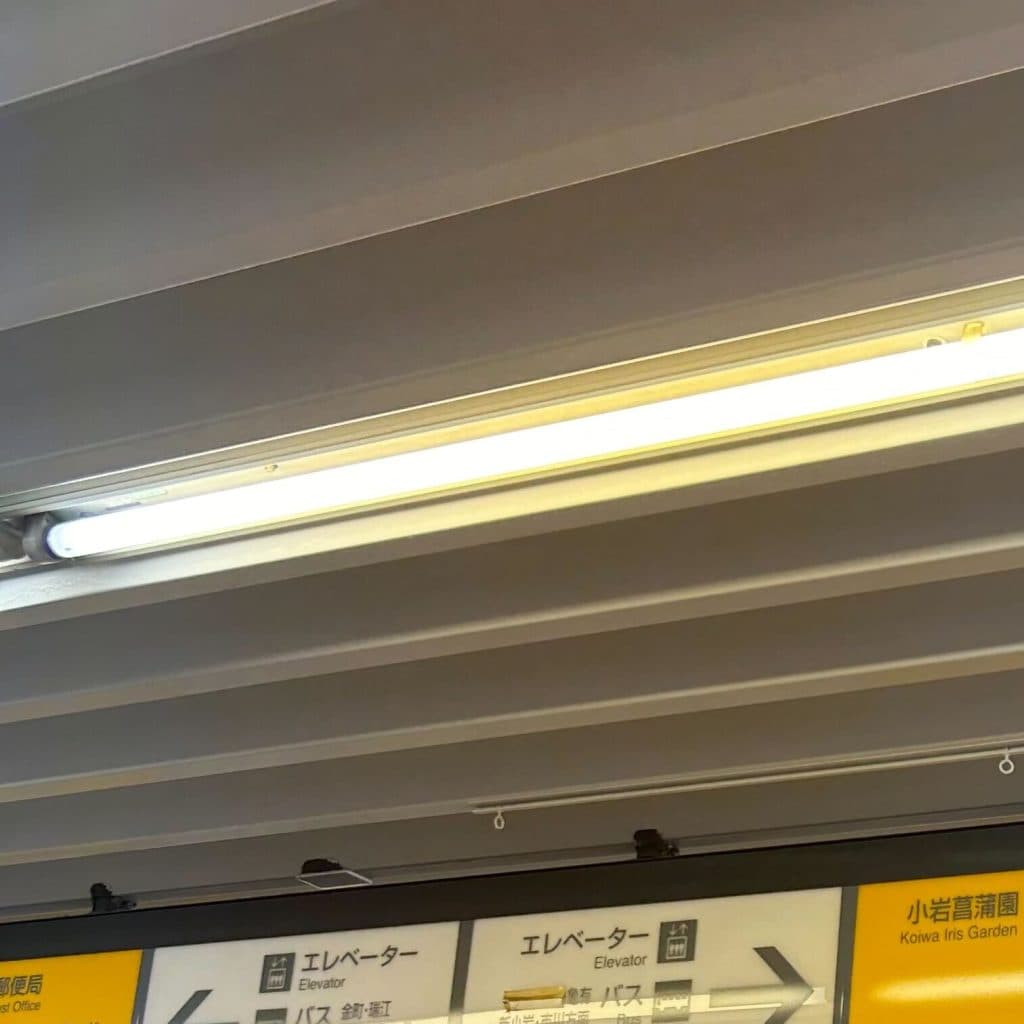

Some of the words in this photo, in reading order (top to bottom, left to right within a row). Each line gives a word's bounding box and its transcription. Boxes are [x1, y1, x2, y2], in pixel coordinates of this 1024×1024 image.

[906, 891, 1020, 925] 小岩菖蒲園
[520, 926, 650, 956] エレベーター
[900, 929, 940, 945] Koiwa
[943, 927, 964, 942] Iris
[967, 923, 1018, 939] Garden
[301, 945, 419, 973] エレベーター
[593, 953, 648, 970] Elevator
[298, 975, 345, 992] Elevator
[13, 1000, 41, 1013] Office
[600, 984, 643, 1007] バス
